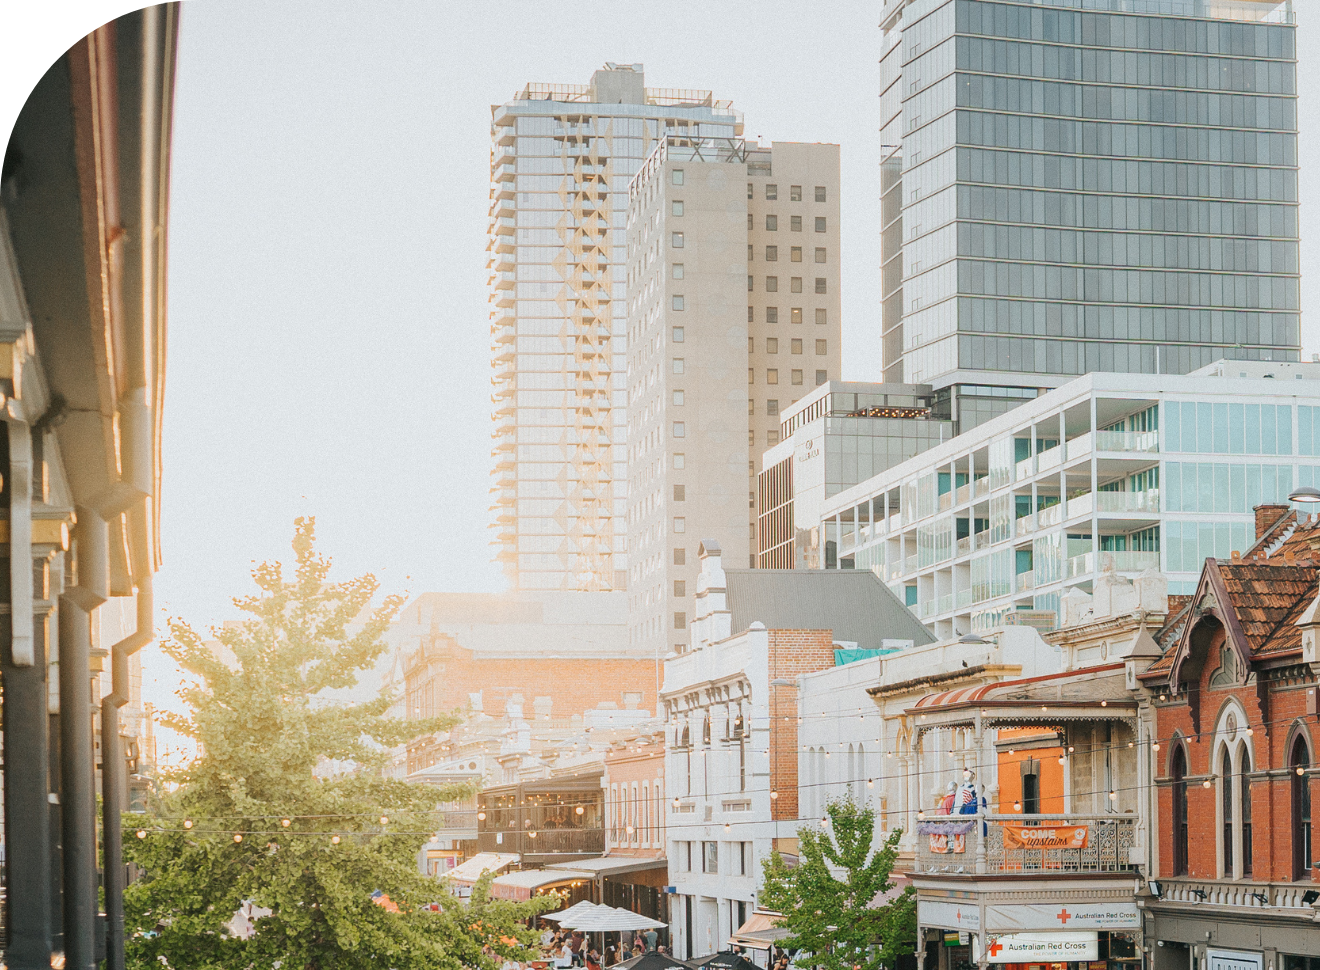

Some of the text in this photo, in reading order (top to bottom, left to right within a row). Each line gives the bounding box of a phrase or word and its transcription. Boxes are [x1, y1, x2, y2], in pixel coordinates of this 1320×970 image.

[1021, 829, 1056, 839] COME
[1027, 836, 1068, 848] upstairs
[1008, 943, 1046, 951] Australian
[1048, 942, 1062, 950] Red
